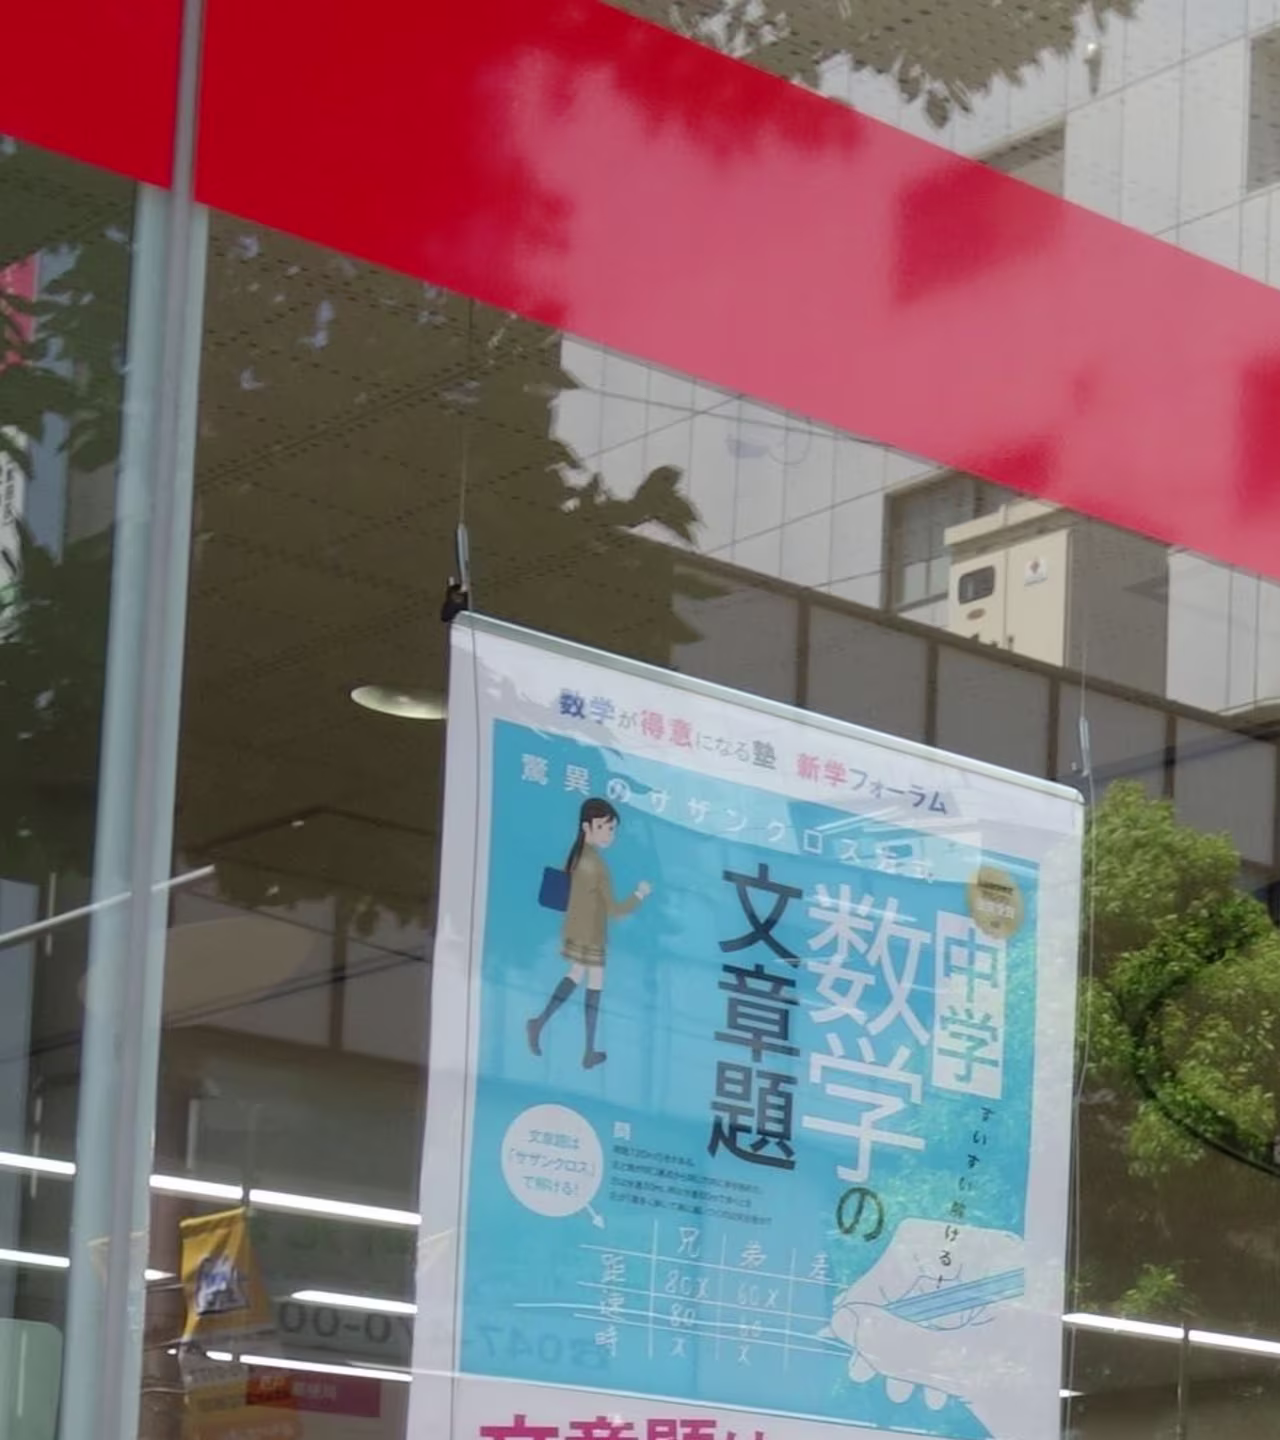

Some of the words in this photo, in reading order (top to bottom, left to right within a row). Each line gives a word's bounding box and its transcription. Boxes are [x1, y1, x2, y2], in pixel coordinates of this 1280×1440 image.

[558, 687, 777, 772] 数学が得意になる塾
[796, 753, 948, 815] 新学フォーラム
[707, 863, 804, 1171] 文章題
[801, 879, 932, 1242] 数学の
[936, 916, 1000, 1083] 中学
